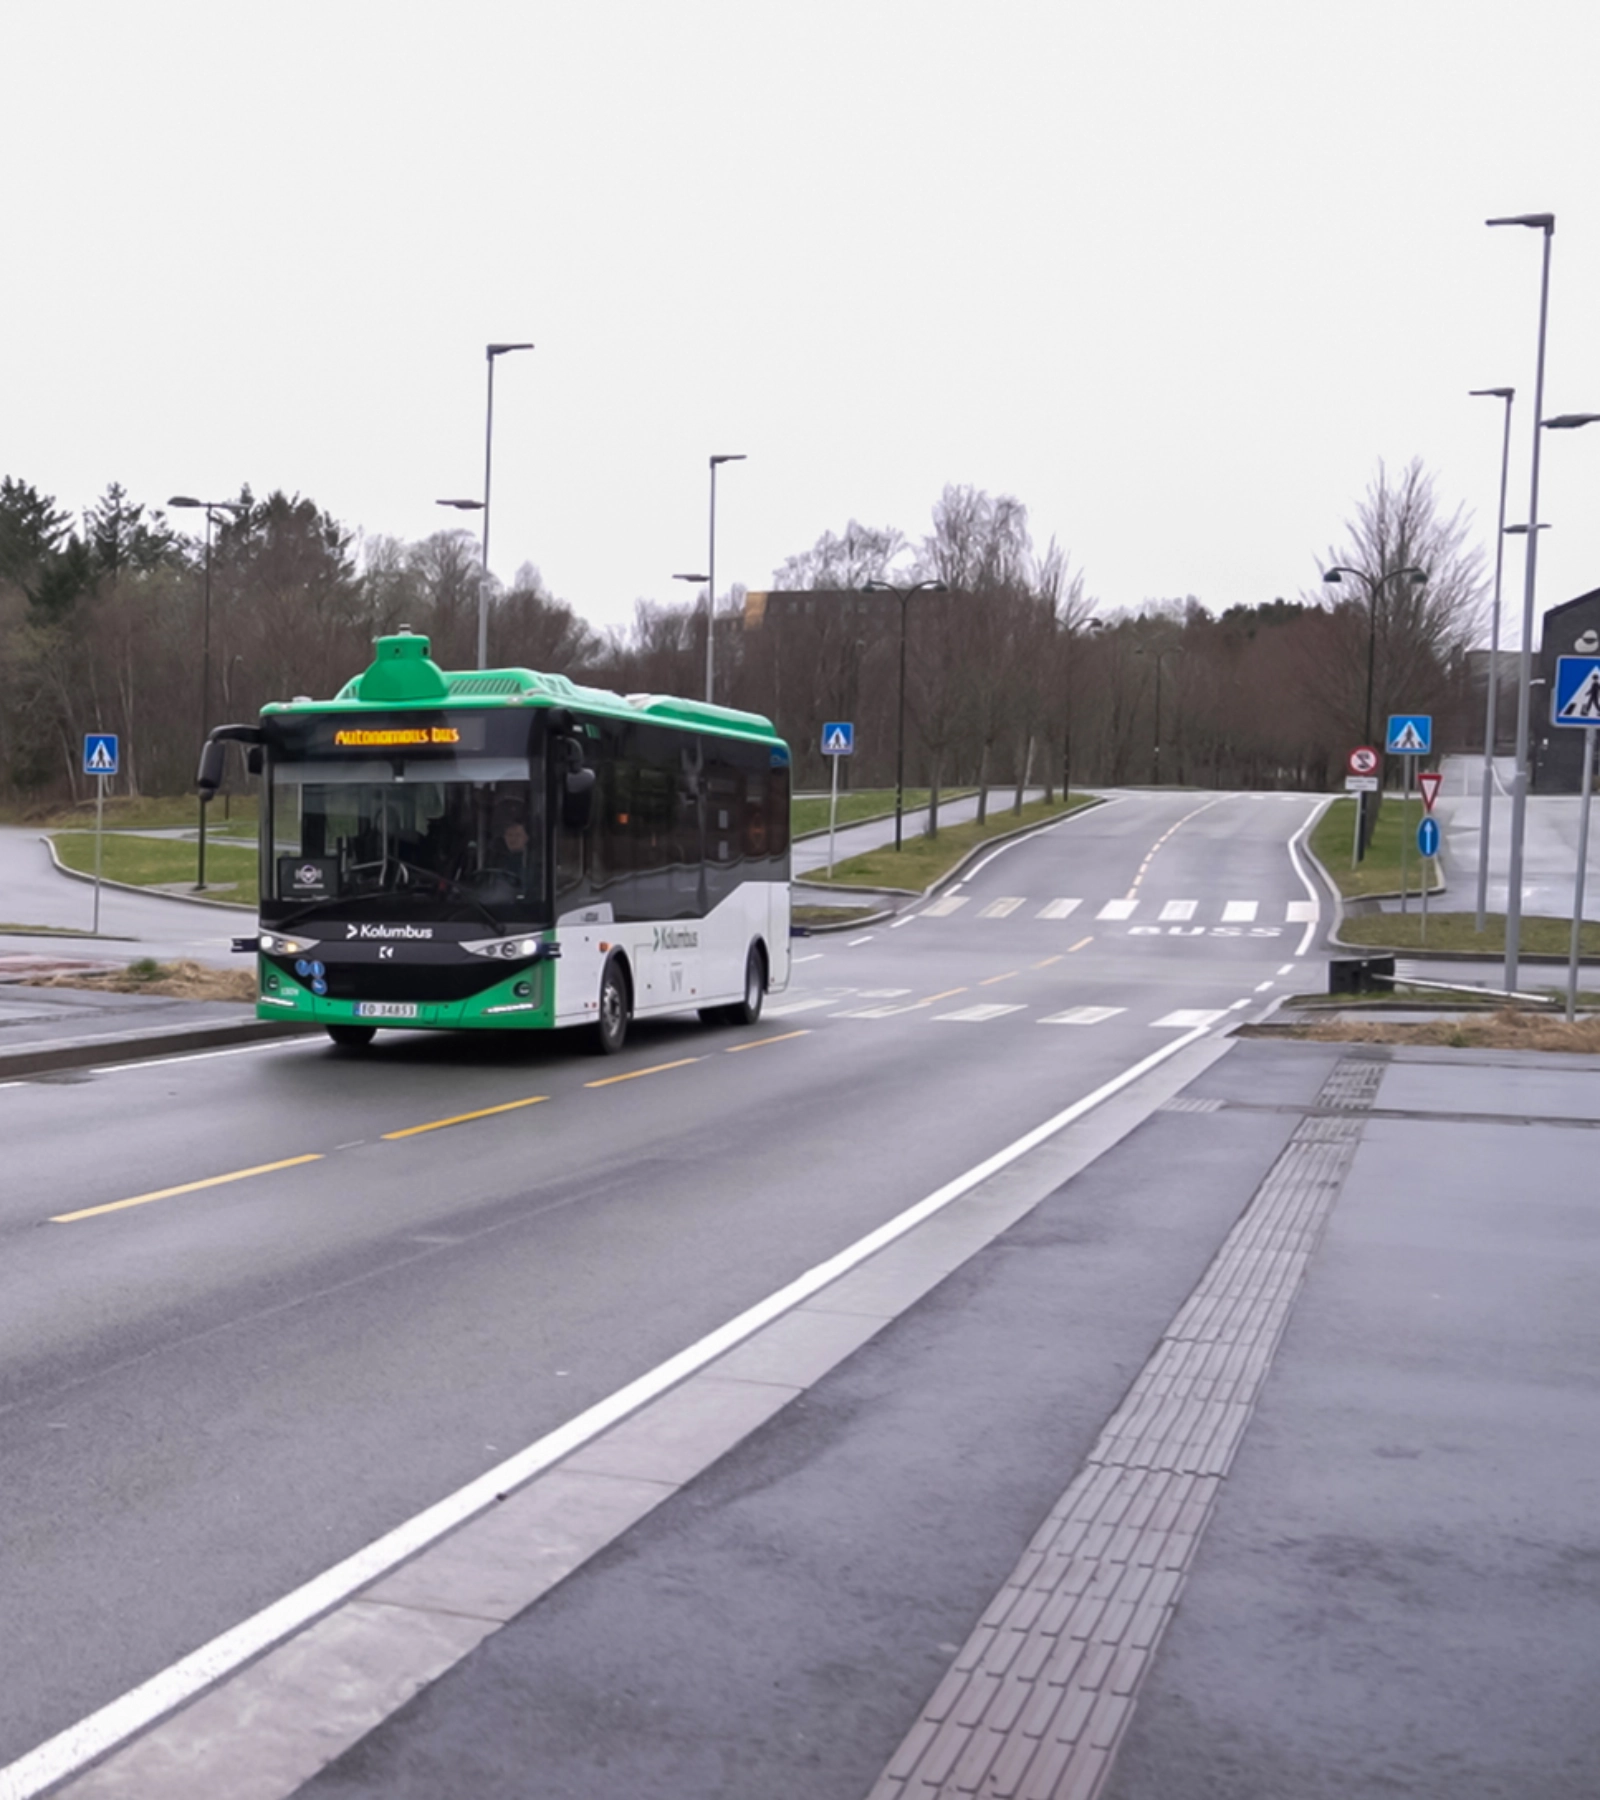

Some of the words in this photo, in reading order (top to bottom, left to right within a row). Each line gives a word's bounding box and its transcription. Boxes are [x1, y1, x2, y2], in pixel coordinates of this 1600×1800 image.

[431, 727, 460, 743] bus
[360, 923, 433, 939] Kolumbus
[661, 927, 698, 949] Kolumbus
